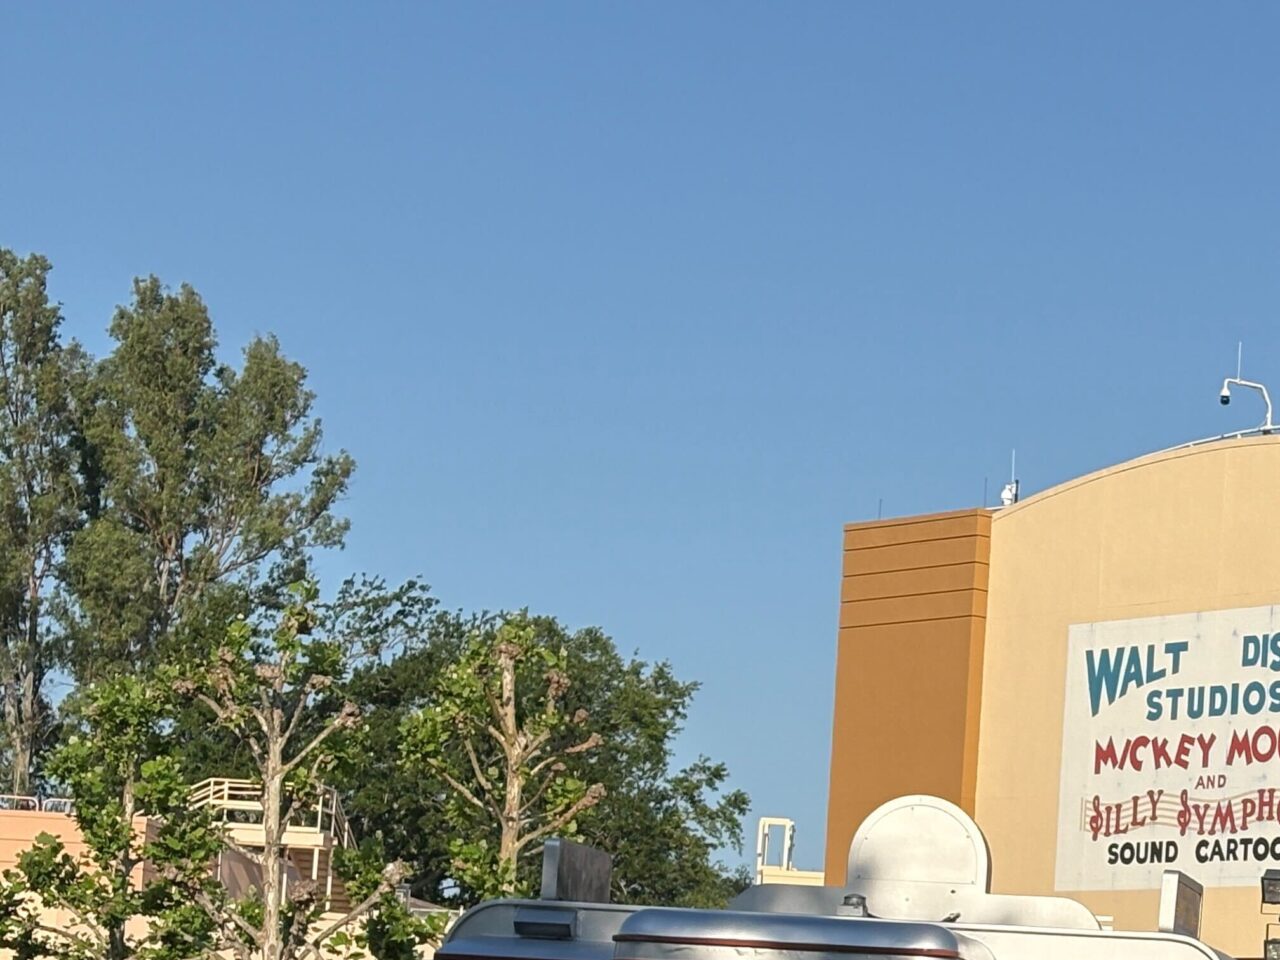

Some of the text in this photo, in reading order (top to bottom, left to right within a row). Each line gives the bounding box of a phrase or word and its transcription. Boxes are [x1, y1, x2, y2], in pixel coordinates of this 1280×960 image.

[1085, 640, 1189, 718] WALT
[1093, 733, 1217, 775] MICKEY
[1194, 774, 1227, 790] AND
[1089, 789, 1164, 841] SILLY
[1107, 840, 1179, 865] SOUND
